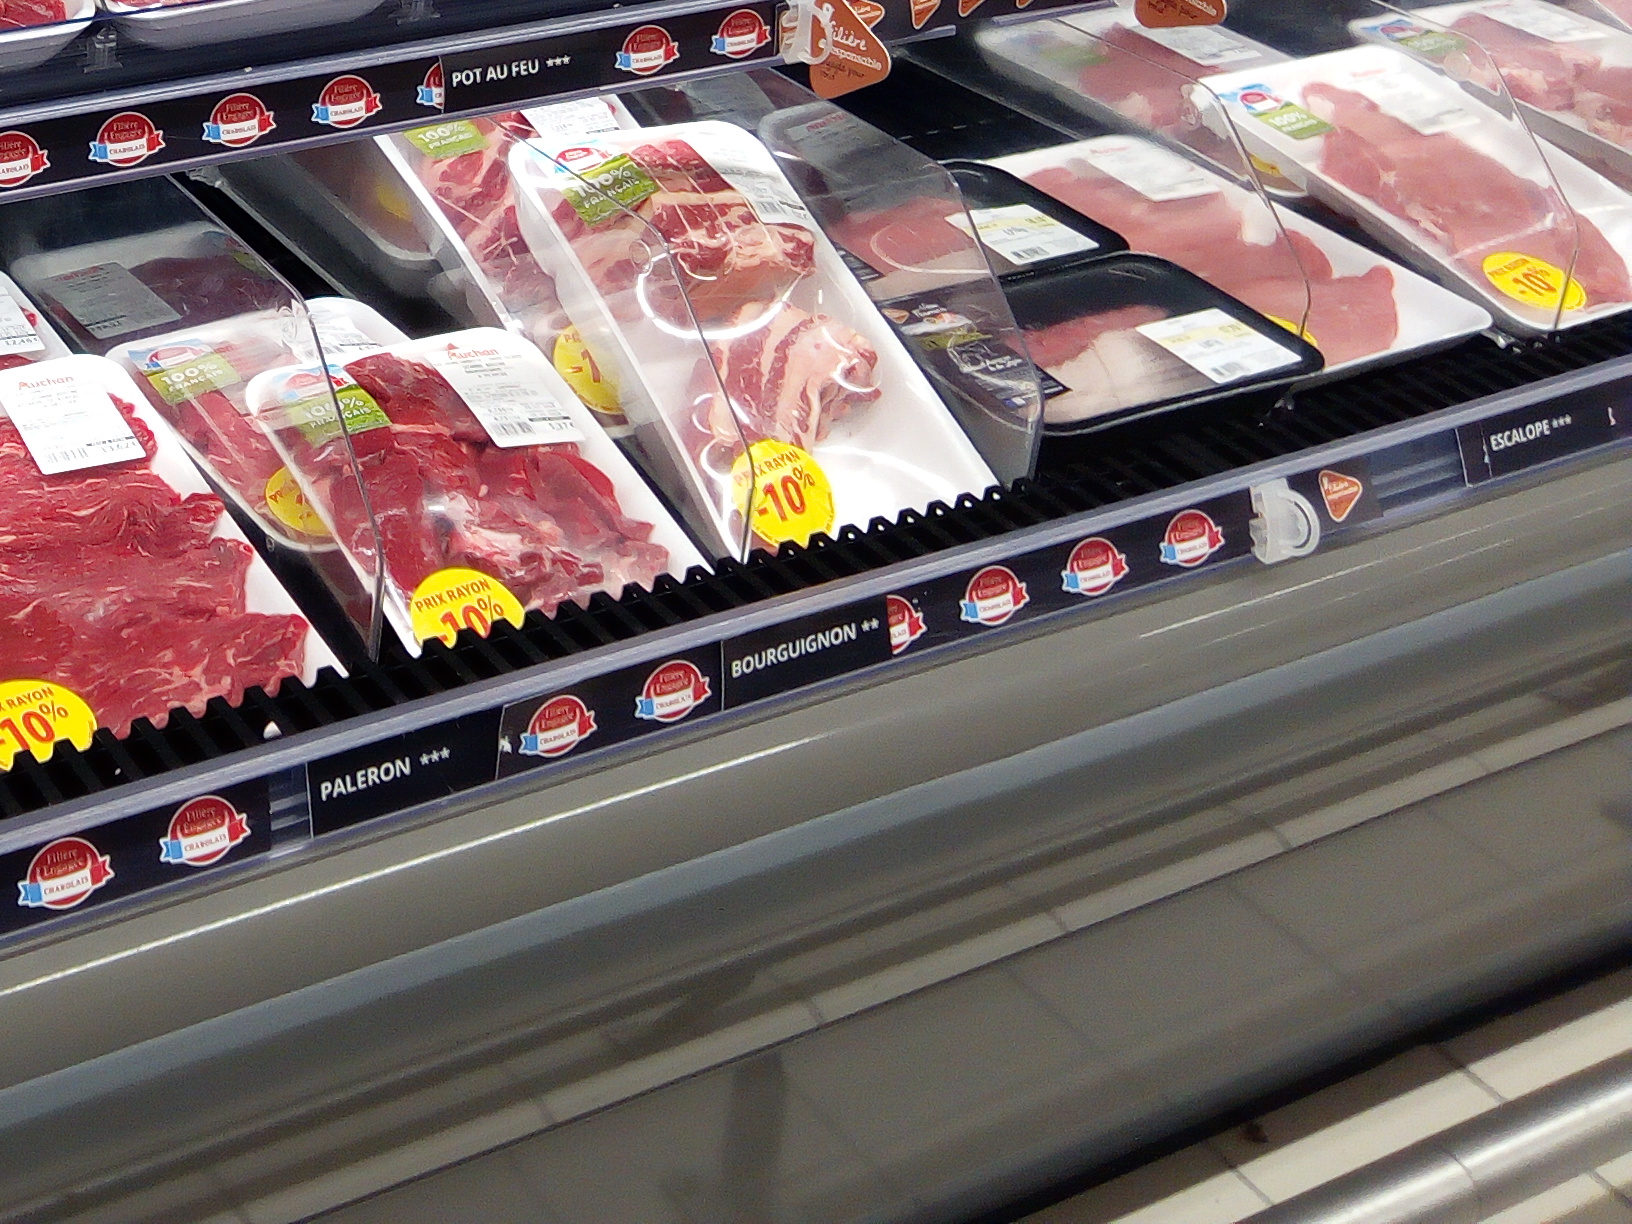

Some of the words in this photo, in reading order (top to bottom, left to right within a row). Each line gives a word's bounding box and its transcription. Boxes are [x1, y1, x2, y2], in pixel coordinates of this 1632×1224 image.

[452, 71, 482, 87] POT
[486, 65, 507, 82] AU
[510, 59, 539, 76] FEU
[417, 124, 467, 143] 100%
[448, 346, 499, 358] Auchan
[19, 376, 75, 390] Auchan
[160, 360, 218, 387] 100%
[1490, 419, 1551, 451] ESCALOPE
[764, 450, 800, 475] RAYON
[757, 465, 815, 523] -10%
[415, 595, 444, 613] PRIX
[446, 579, 491, 600] RAYON
[731, 623, 857, 678] BOURGUIGNON
[6, 687, 54, 709] RAYON
[320, 757, 412, 801] PALERON
[185, 834, 227, 852] CHAROLAIS
[44, 877, 89, 895] CHAROLAIS
